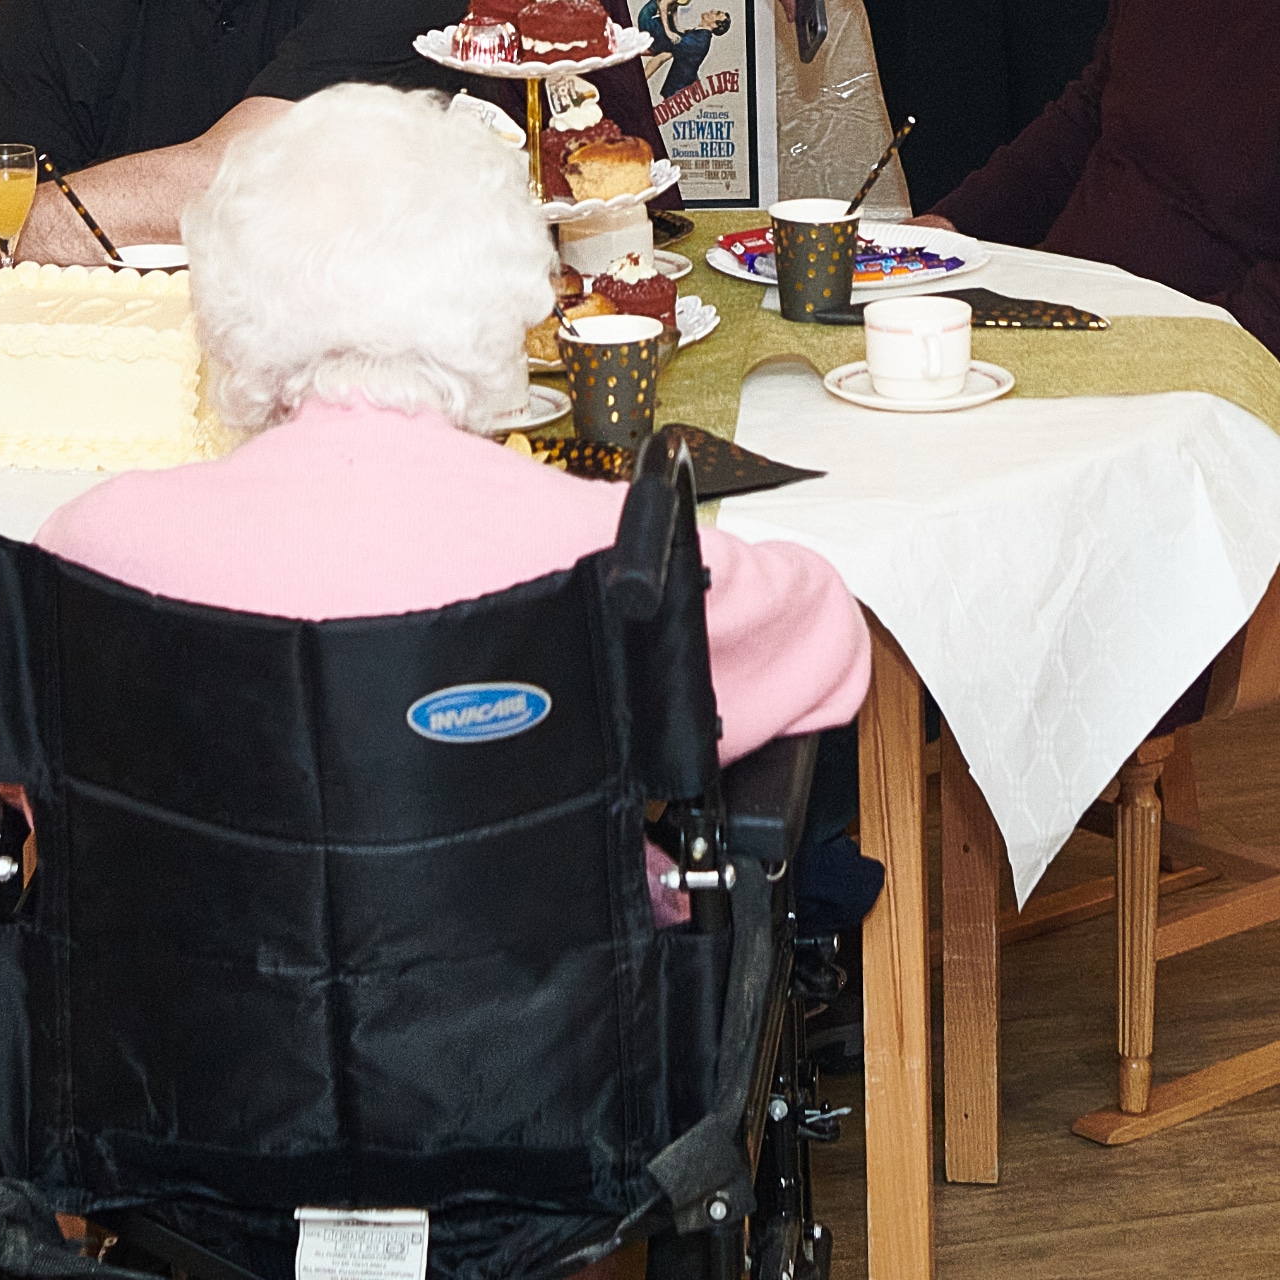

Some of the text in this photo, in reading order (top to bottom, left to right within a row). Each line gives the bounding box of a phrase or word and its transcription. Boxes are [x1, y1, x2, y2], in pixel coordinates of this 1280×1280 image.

[696, 108, 730, 120] James
[672, 120, 735, 141] STEWART
[671, 141, 736, 158] Donna REED
[429, 691, 527, 733] INVACARE
